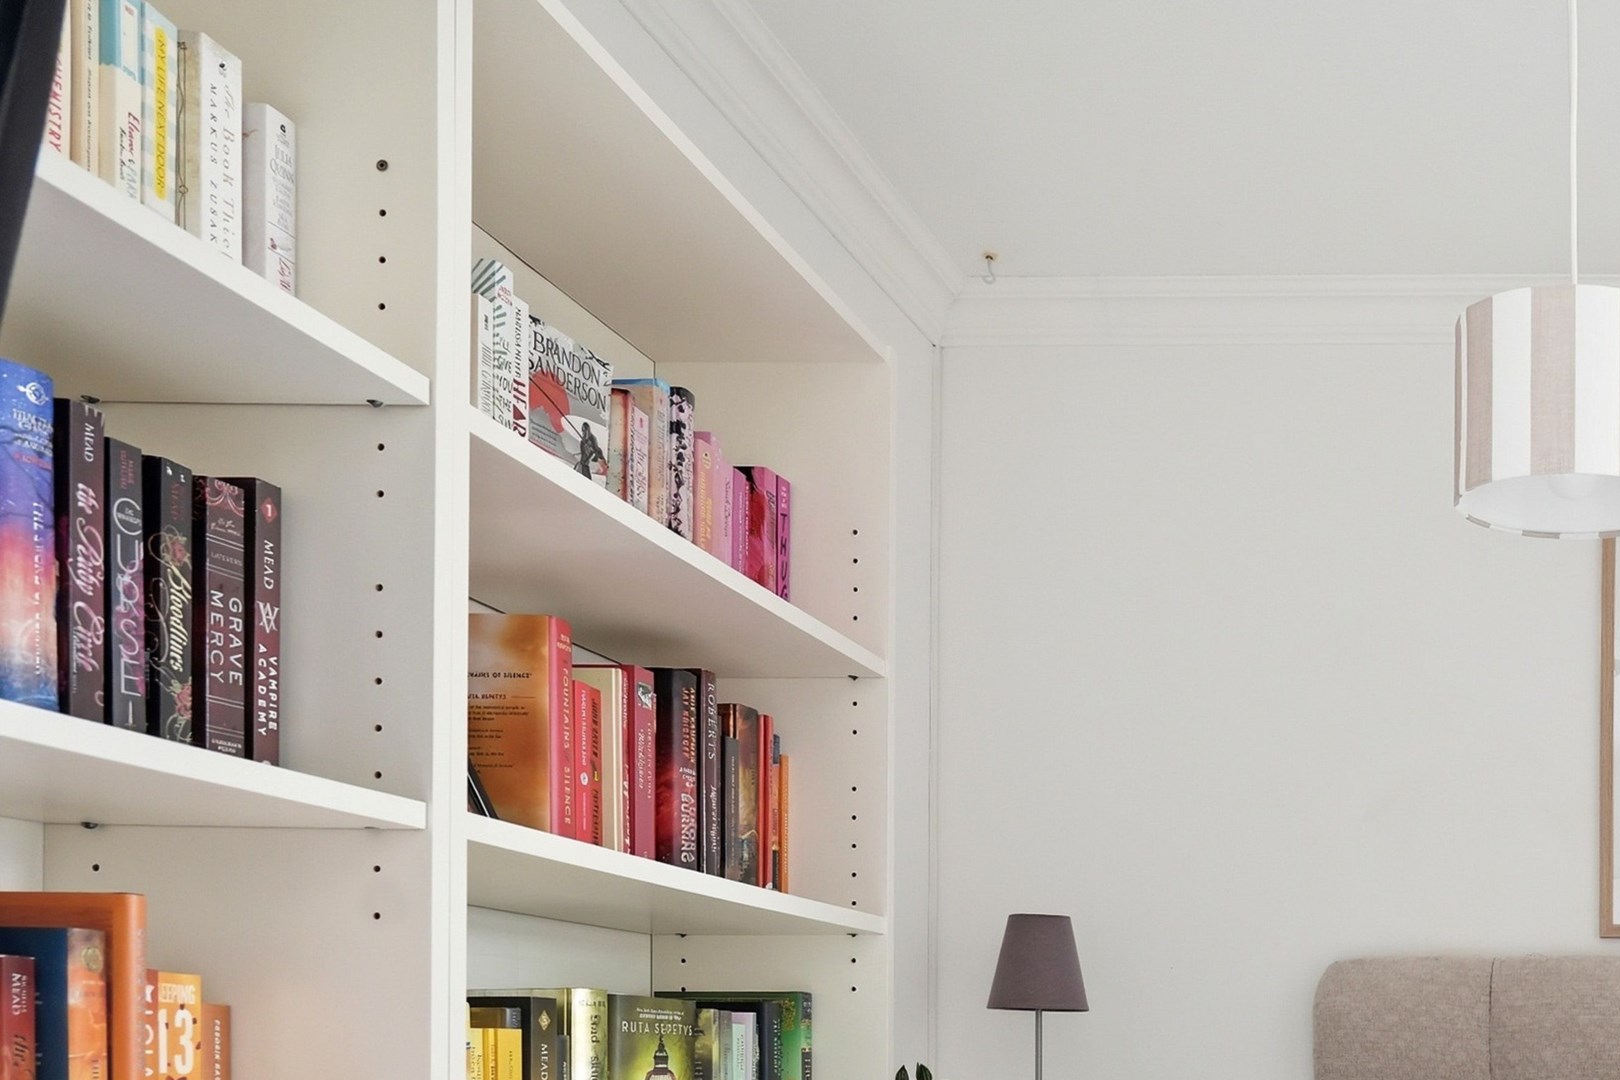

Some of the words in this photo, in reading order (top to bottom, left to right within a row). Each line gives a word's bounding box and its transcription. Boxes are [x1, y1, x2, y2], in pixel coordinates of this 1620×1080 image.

[157, 66, 166, 98] LIFE
[157, 101, 166, 138] NEXT
[209, 83, 219, 165] MARKUS
[157, 142, 166, 189] DOOR
[223, 128, 236, 187] Book
[532, 330, 601, 388] BRANDON
[83, 422, 96, 462] MEAD
[76, 483, 100, 514] the
[67, 517, 105, 597] Ruby
[263, 539, 275, 590] MEAD
[72, 600, 105, 673] Circle
[167, 565, 193, 673] Bloodlines
[210, 589, 225, 684] MERCY
[228, 597, 243, 687] GRAVE
[257, 643, 268, 737] ACADEMY
[267, 656, 278, 732] VAMPIRE
[707, 682, 717, 760] ROBERTS
[563, 766, 571, 825] SILENCE
[11, 972, 22, 1015] MEAD
[158, 983, 195, 1004] EEPING
[159, 1008, 194, 1075] 13
[621, 1020, 650, 1034] RUTA
[653, 1022, 693, 1037] SEPETYS
[540, 1043, 549, 1080] MEAD
